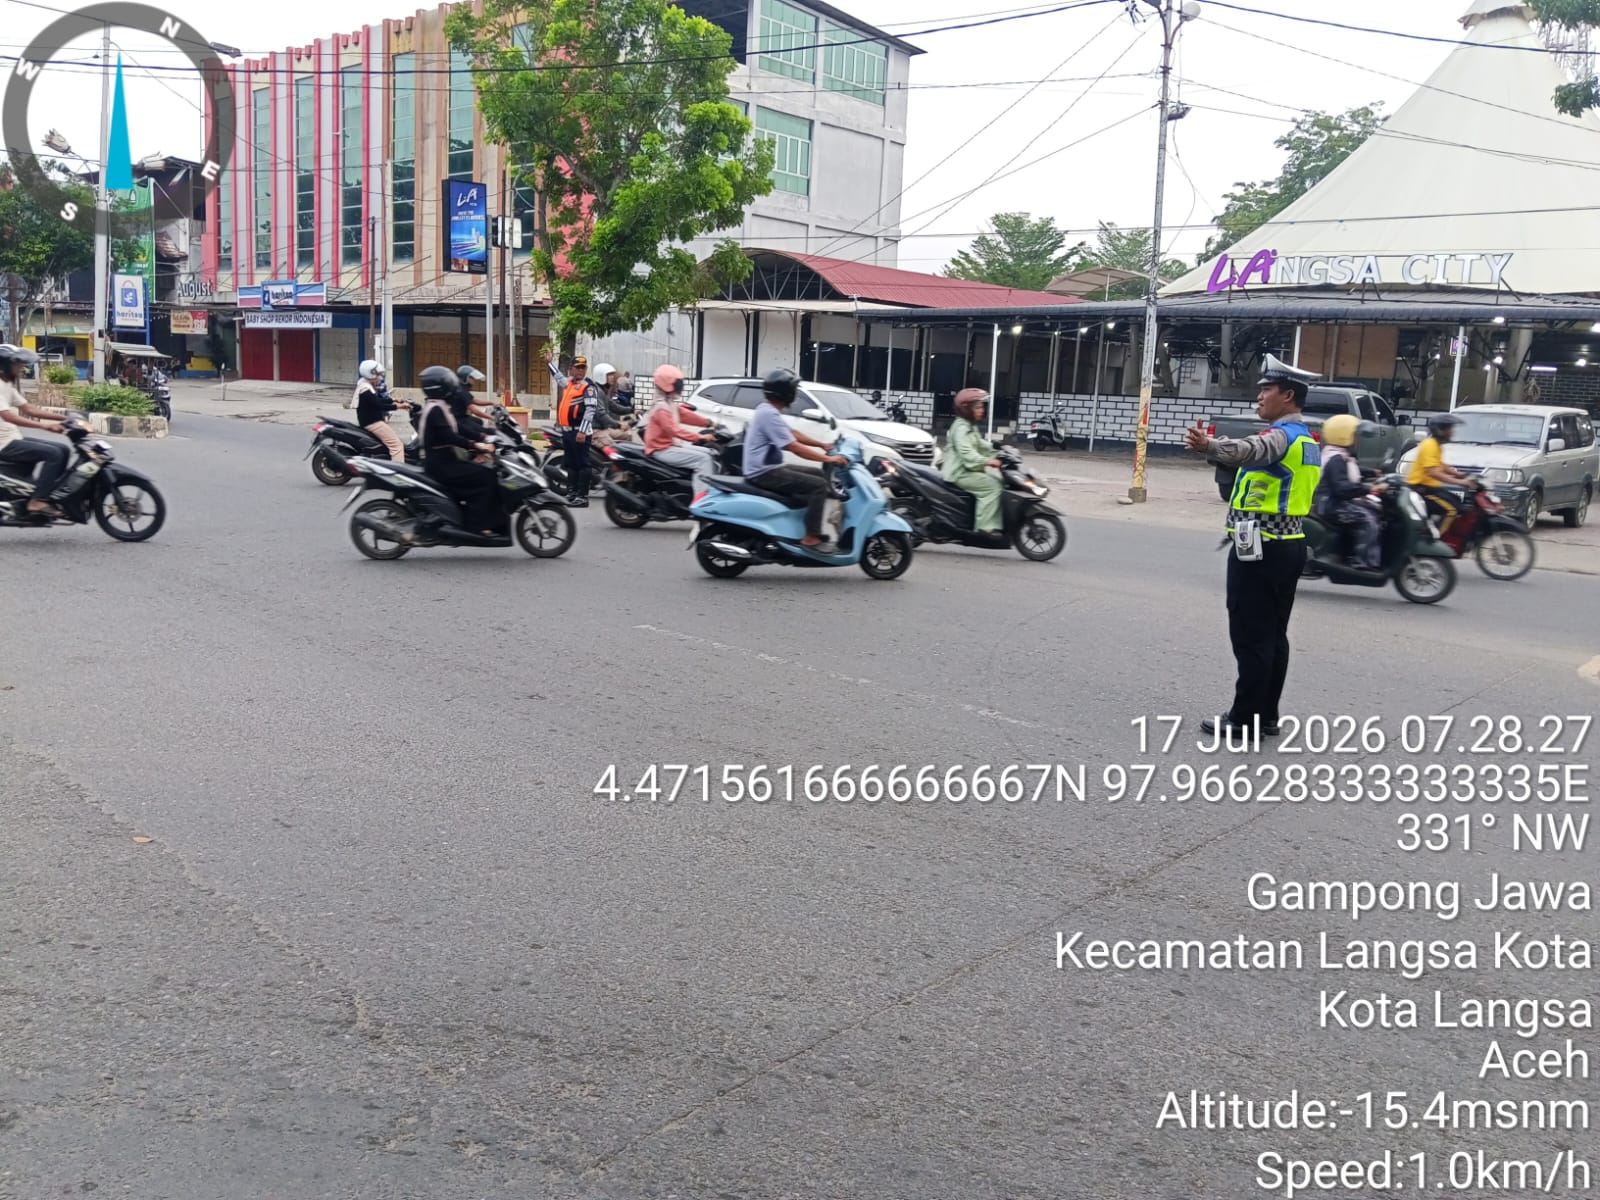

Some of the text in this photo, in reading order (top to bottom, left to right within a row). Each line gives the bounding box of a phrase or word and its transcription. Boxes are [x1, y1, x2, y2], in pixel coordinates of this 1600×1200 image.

[1401, 253, 1514, 285] CITY
[177, 278, 213, 300] August
[246, 314, 259, 324] BABY
[260, 314, 274, 324] SHOP
[293, 313, 325, 324] INDONESIA
